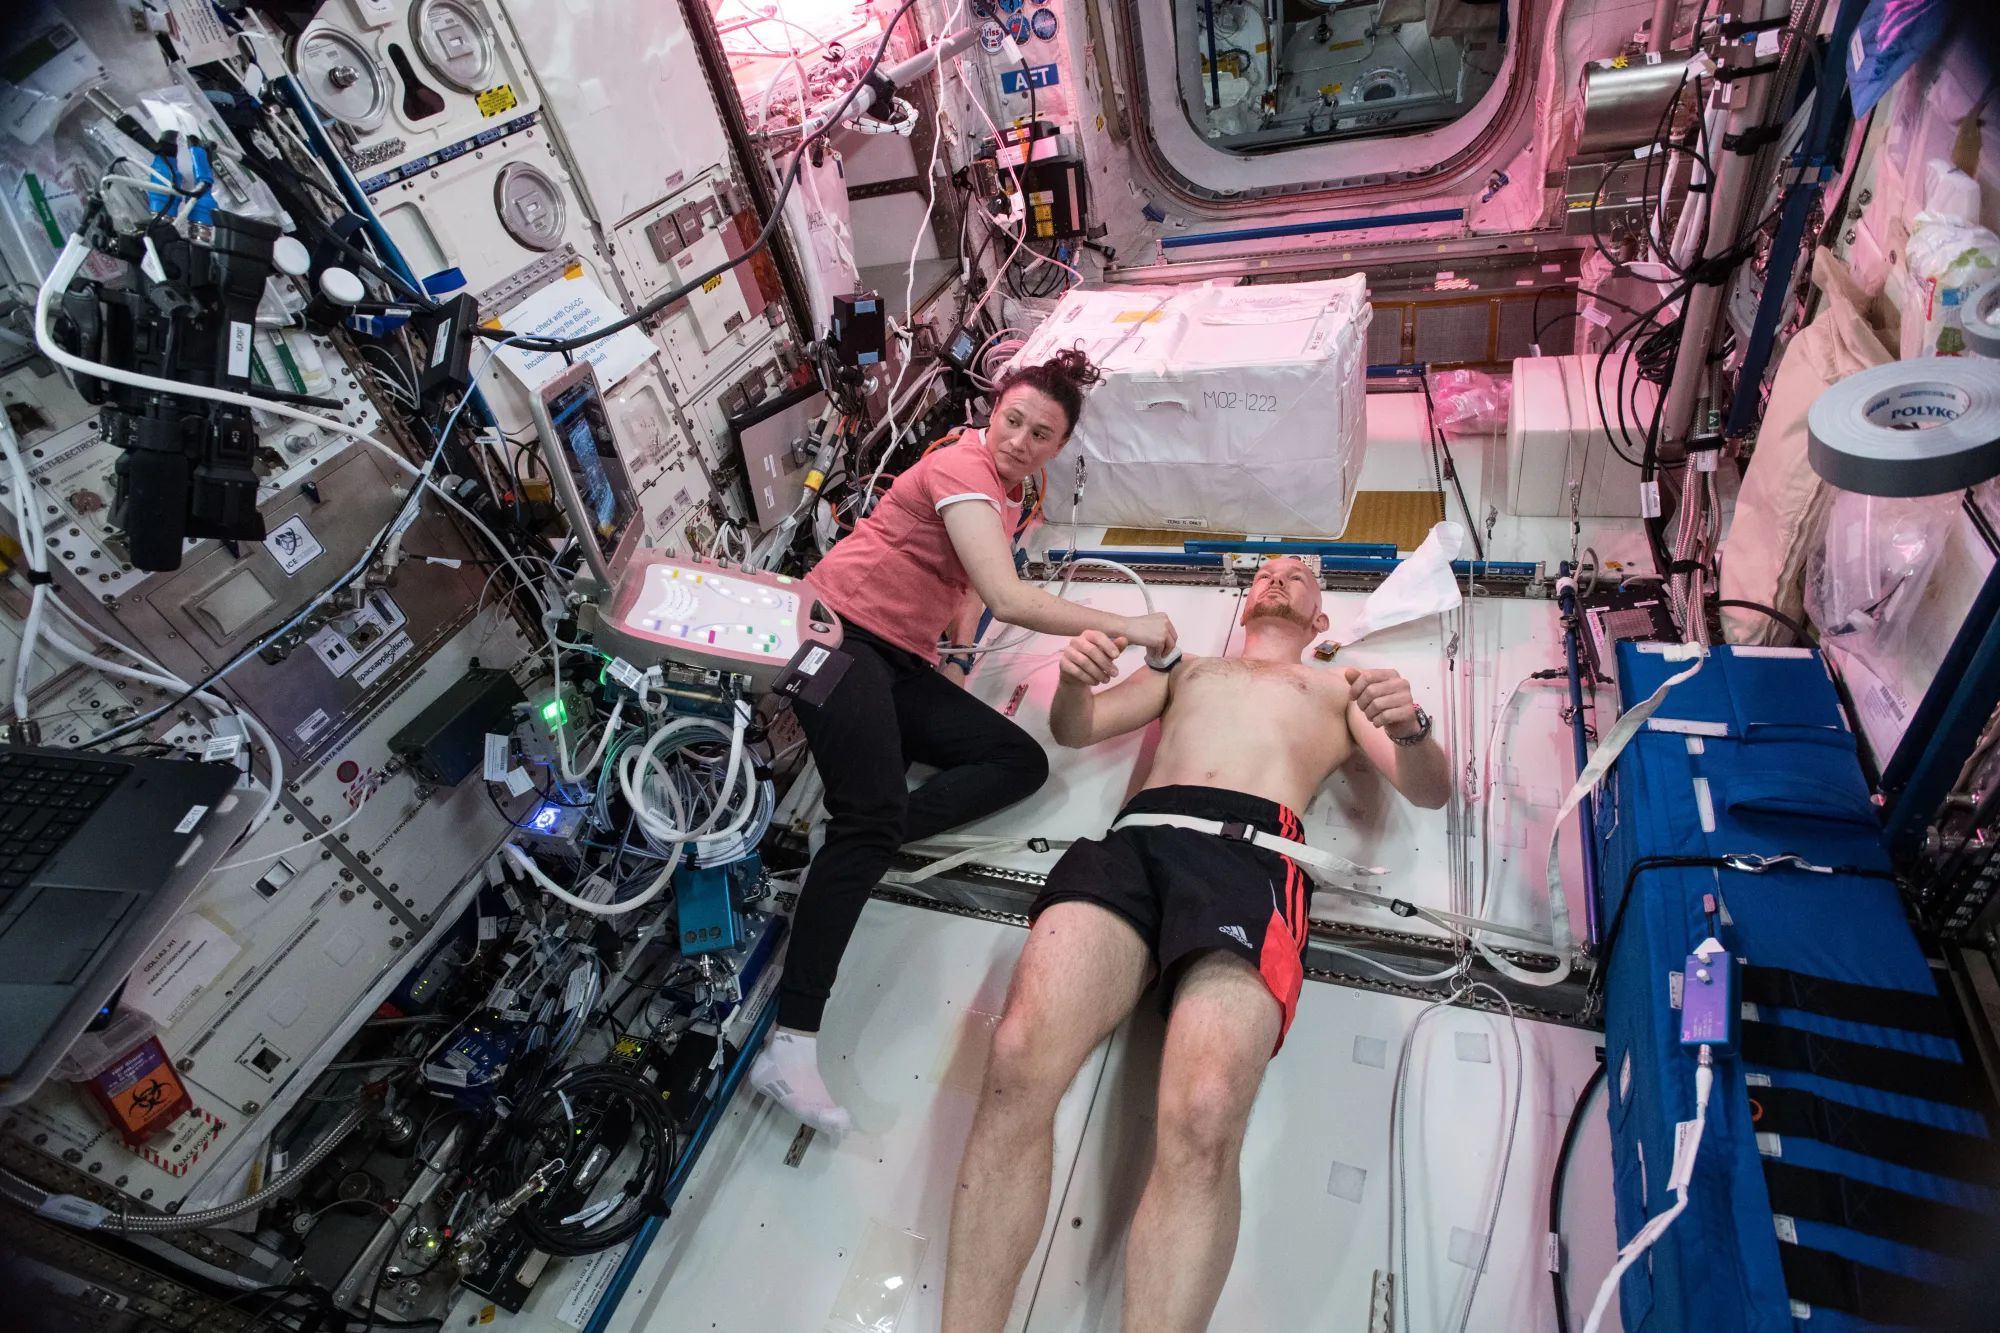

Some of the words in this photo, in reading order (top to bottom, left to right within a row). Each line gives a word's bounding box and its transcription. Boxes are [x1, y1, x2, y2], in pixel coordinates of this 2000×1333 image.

[983, 27, 1000, 37] iriss
[1015, 67, 1049, 91] AFT
[535, 317, 551, 332] check
[552, 309, 563, 320] with
[564, 318, 572, 327] the
[573, 306, 590, 321] Biolab
[587, 315, 599, 325] Door
[355, 634, 409, 683] spaceapplications
[335, 718, 372, 751] MANAGEMENT
[371, 699, 392, 720] SYSTEM
[390, 681, 411, 702] ACCESS
[409, 667, 427, 684] PANEL
